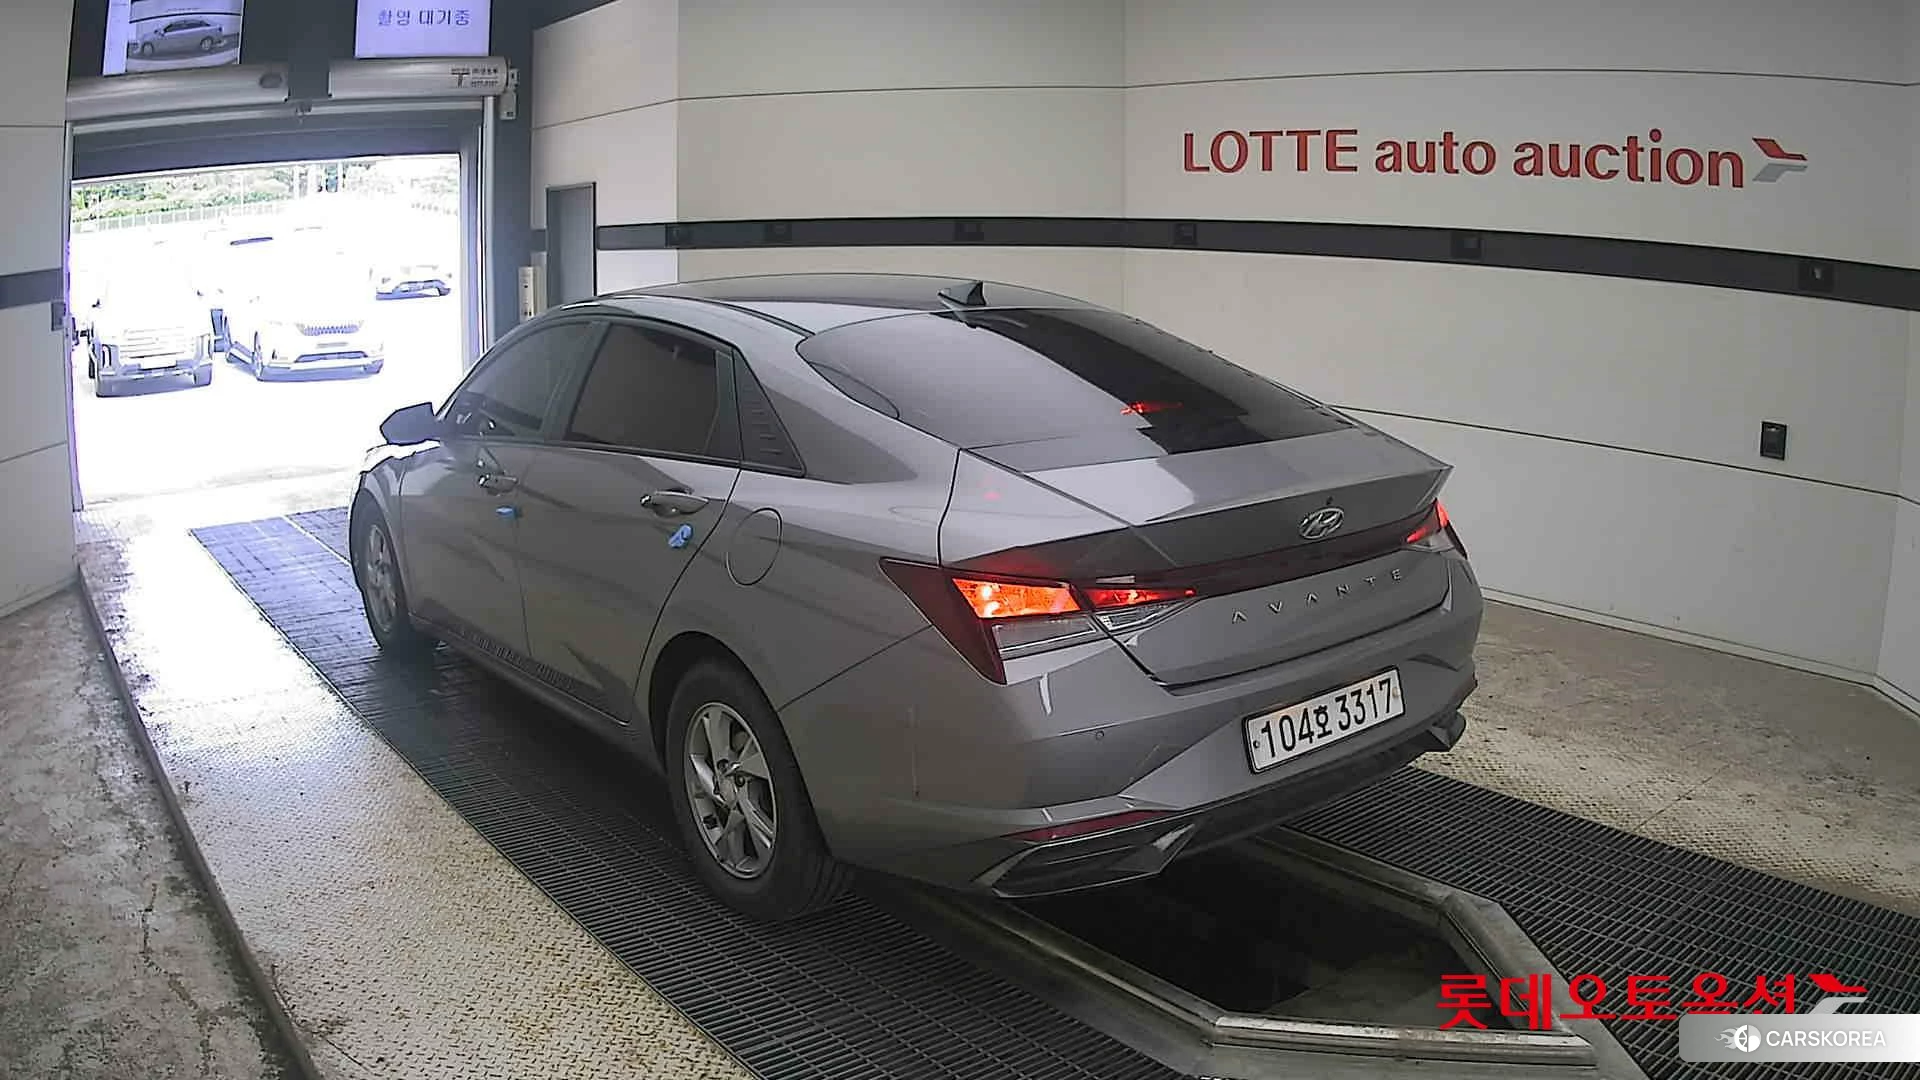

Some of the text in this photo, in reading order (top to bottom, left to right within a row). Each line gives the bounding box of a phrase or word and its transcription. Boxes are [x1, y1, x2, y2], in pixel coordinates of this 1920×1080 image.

[419, 9, 470, 26] 대기중
[1184, 129, 1744, 188] LOTTE auto auction
[1231, 568, 1403, 624] AVANTE
